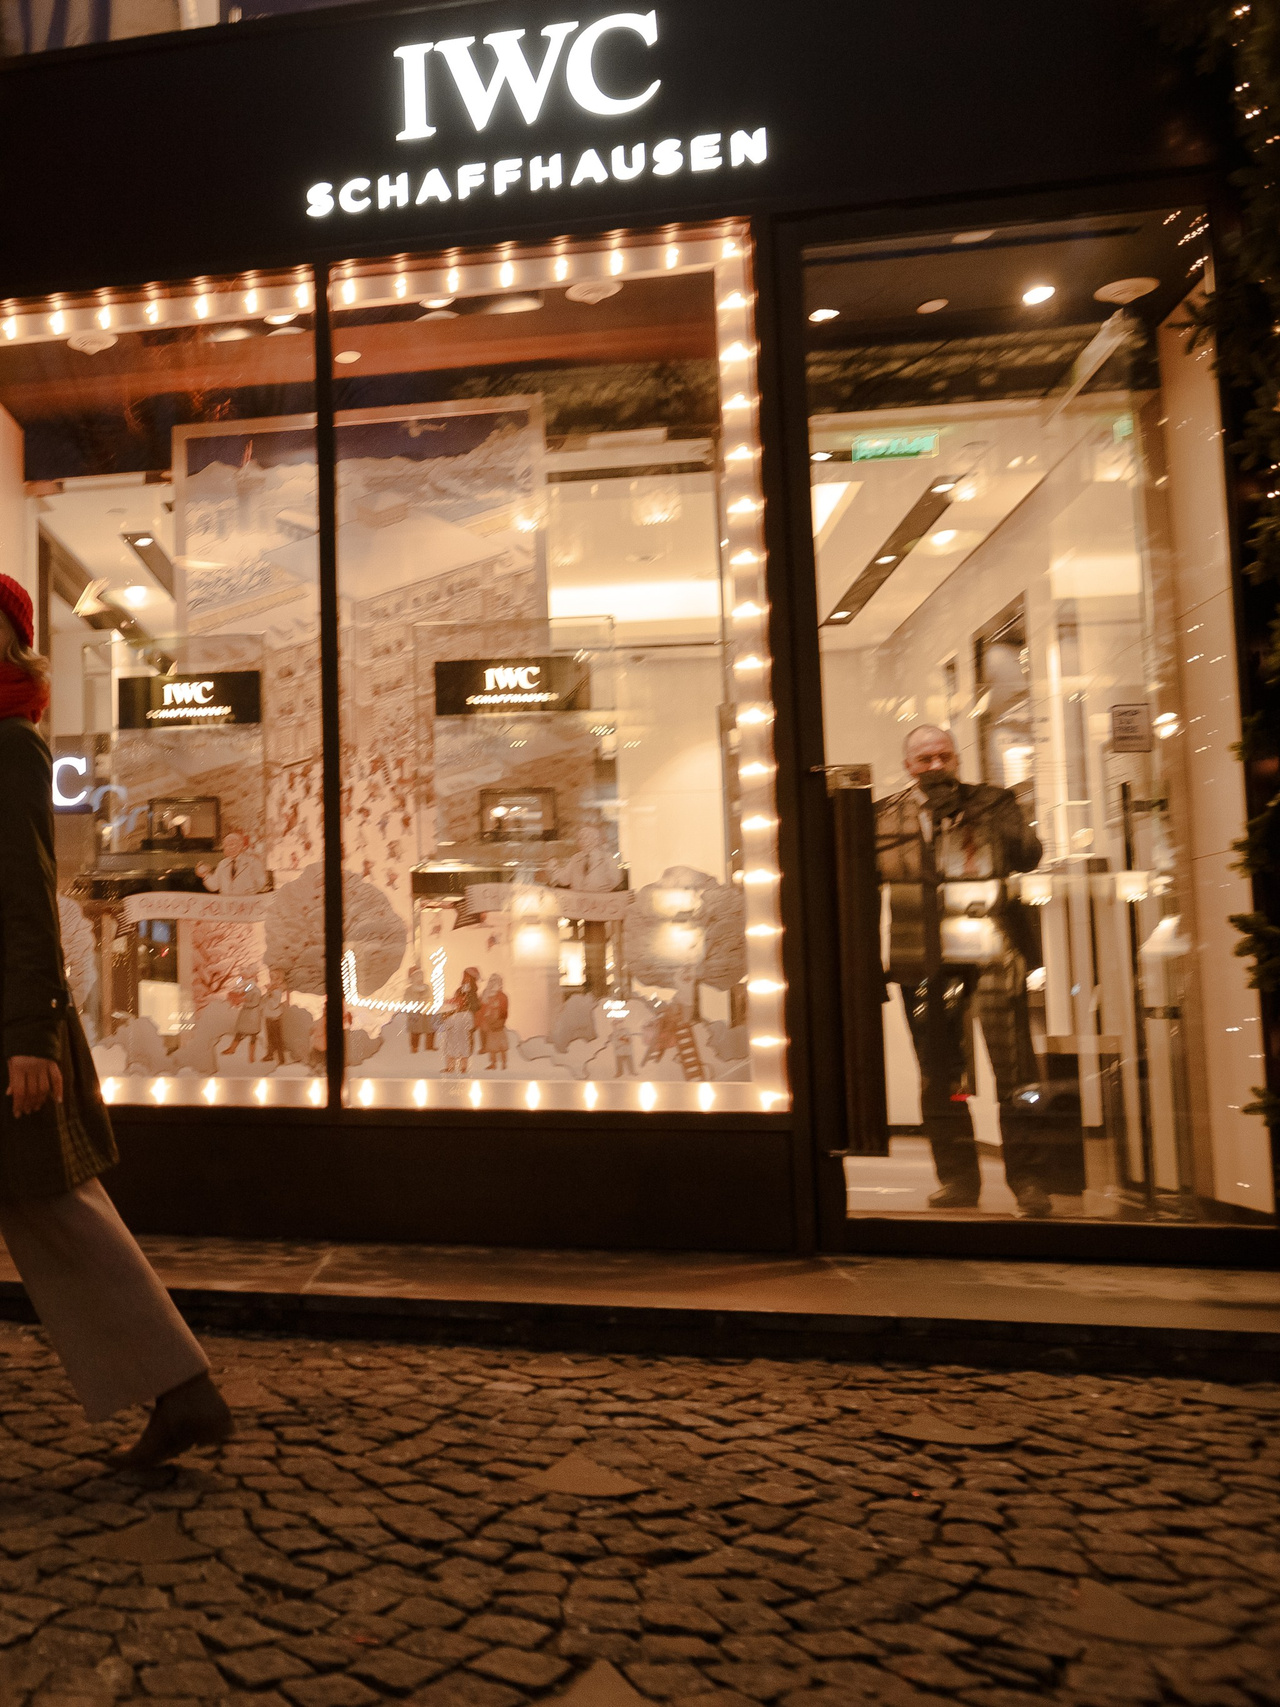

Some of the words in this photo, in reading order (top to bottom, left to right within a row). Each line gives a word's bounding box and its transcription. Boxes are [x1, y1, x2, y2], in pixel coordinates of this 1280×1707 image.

[393, 9, 662, 142] IWC
[306, 127, 768, 218] SCHAFFHAUSEN
[162, 681, 215, 706] IWC
[483, 665, 541, 691] IWC
[52, 756, 88, 807] C
